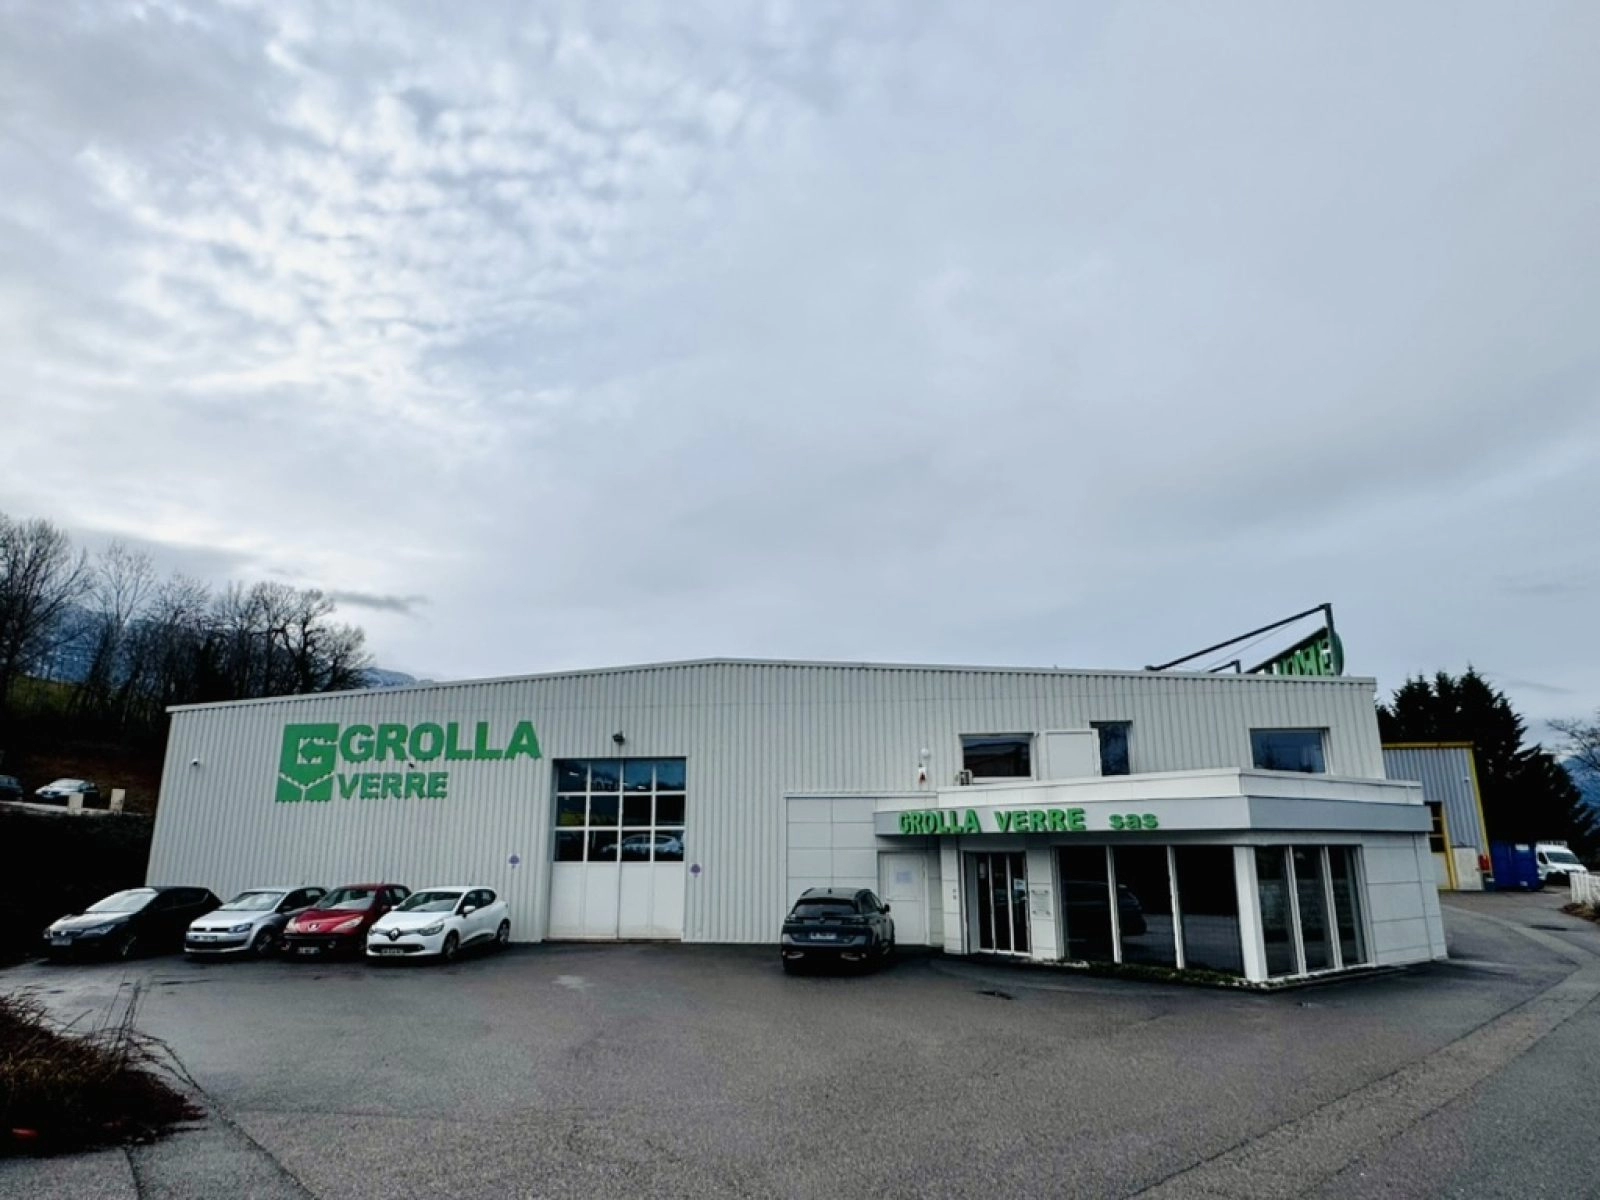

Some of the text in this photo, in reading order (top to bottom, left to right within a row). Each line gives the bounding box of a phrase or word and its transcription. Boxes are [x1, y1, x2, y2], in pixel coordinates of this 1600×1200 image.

[339, 721, 542, 762] GROLLA
[337, 772, 449, 800] VERRE
[899, 808, 1159, 834] GROLLA VERRE sas
